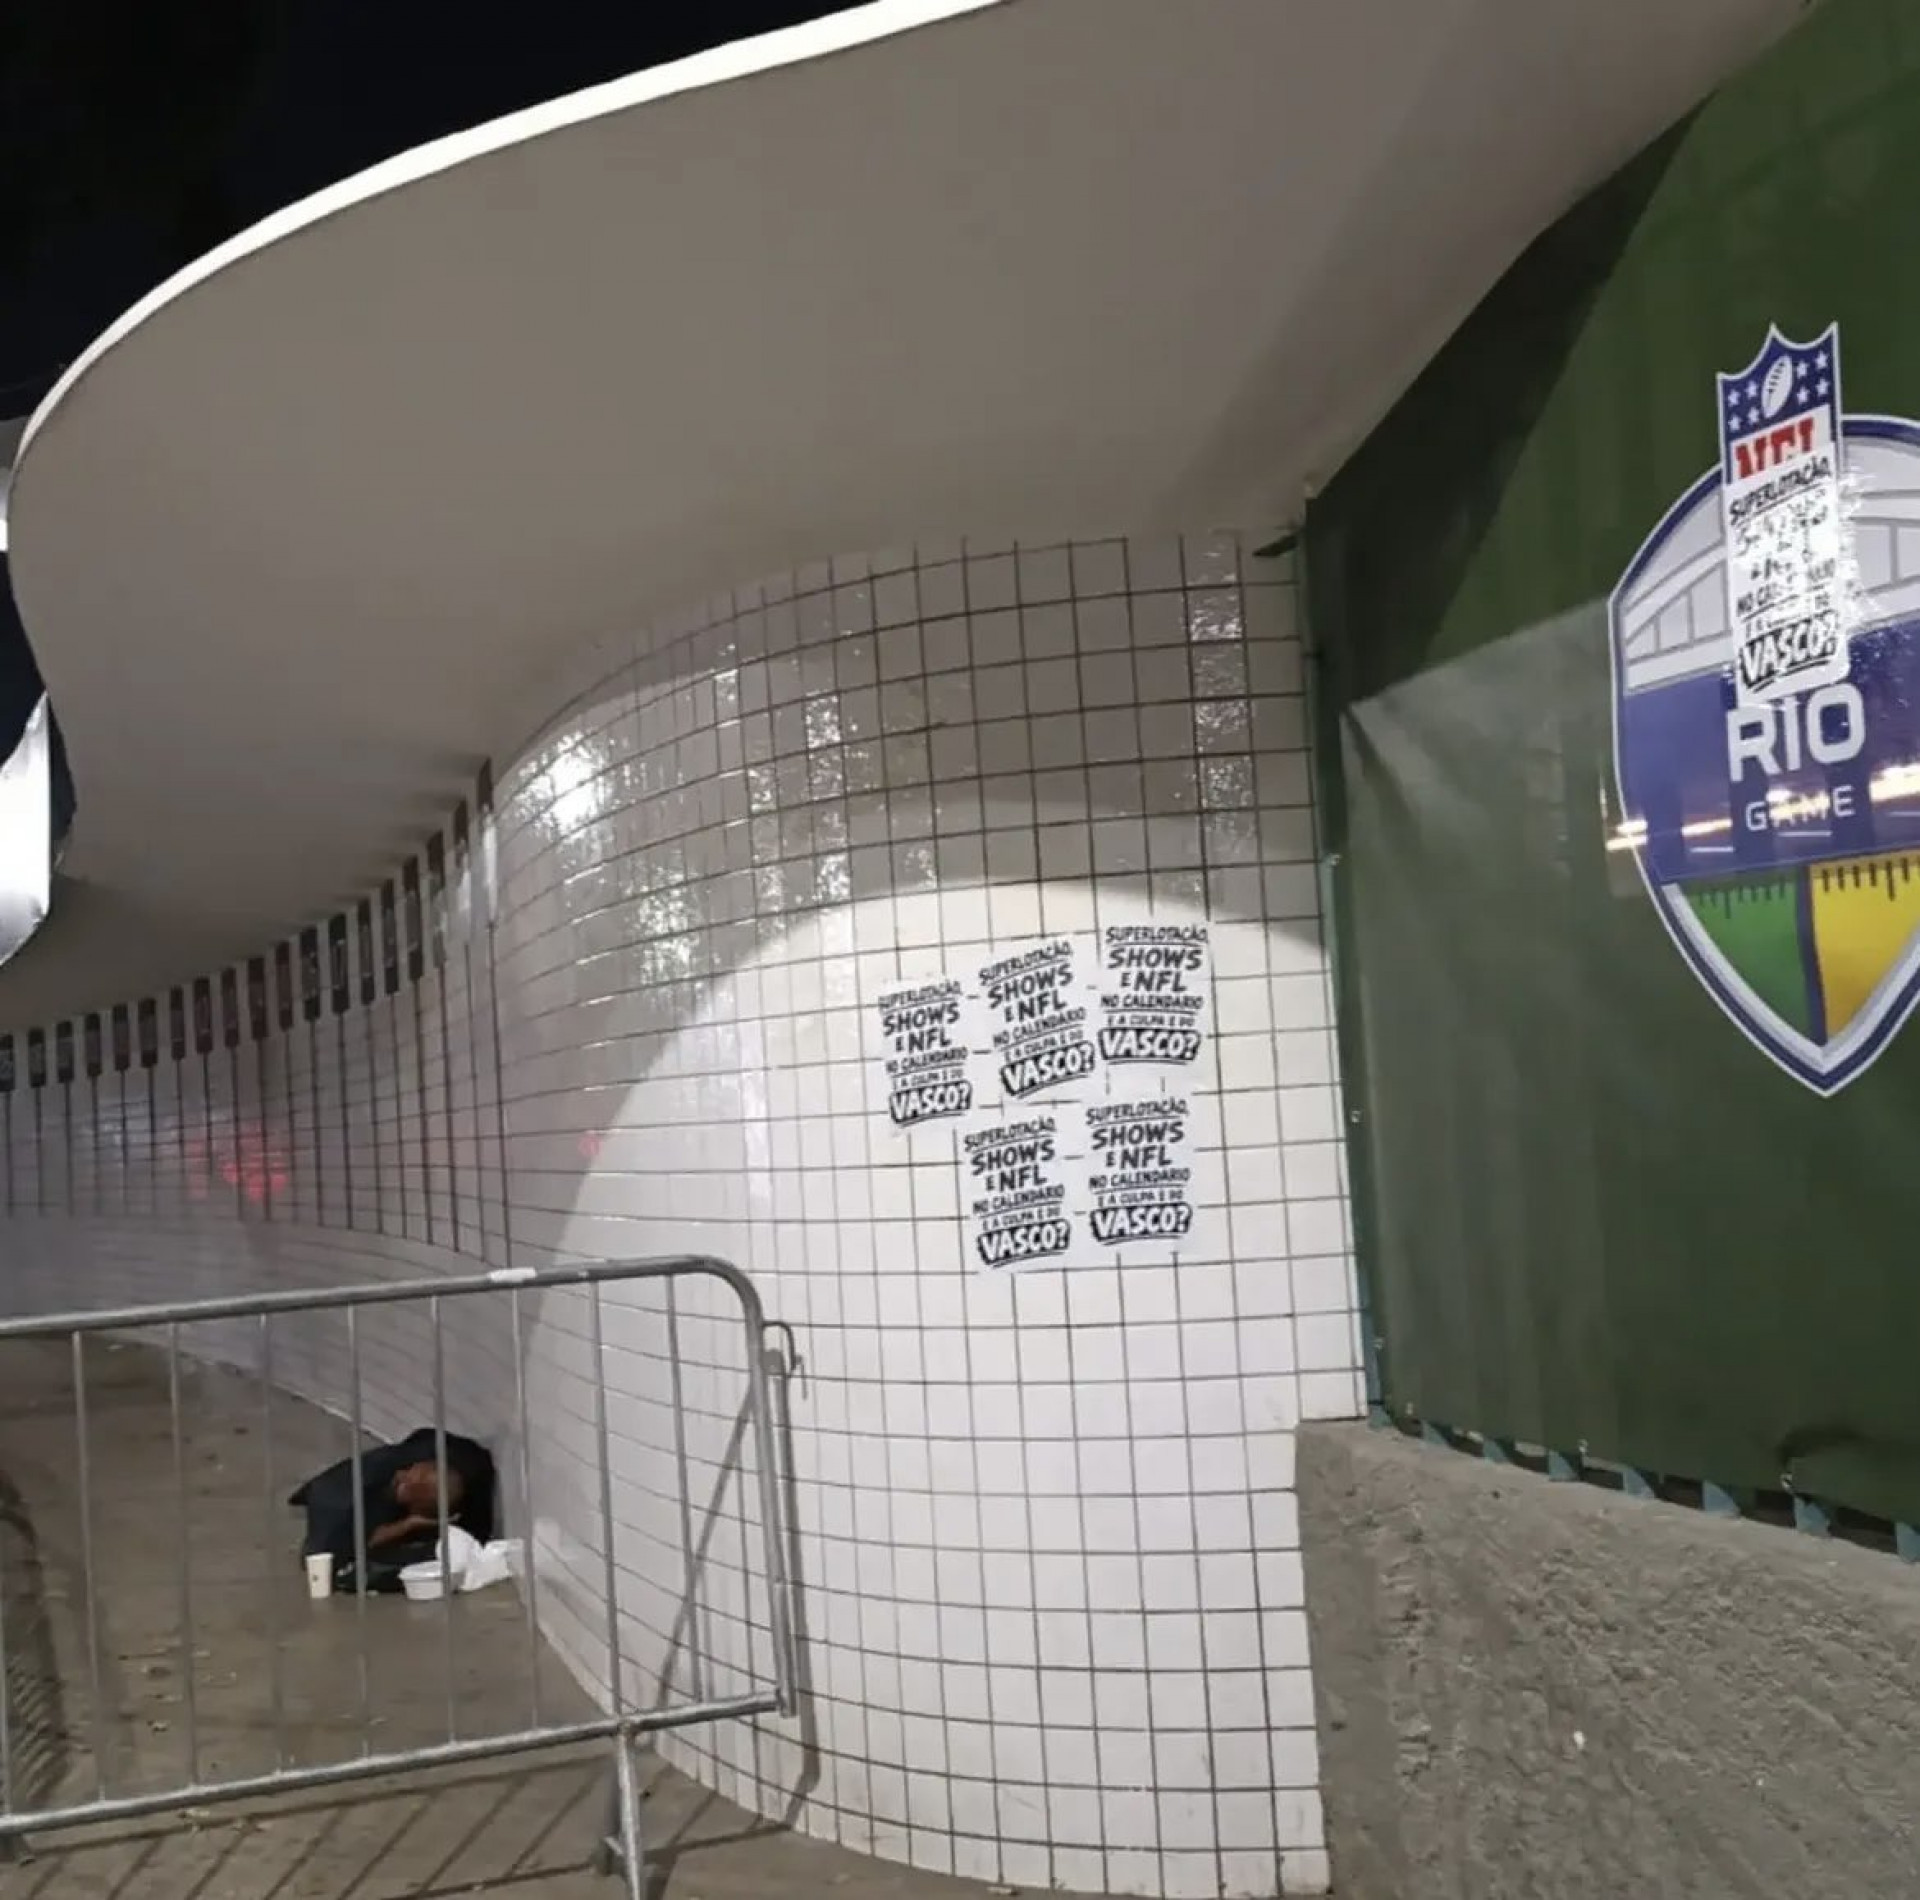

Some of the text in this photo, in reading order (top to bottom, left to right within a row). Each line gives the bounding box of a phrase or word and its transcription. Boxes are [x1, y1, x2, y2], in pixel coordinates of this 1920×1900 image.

[1727, 682, 1865, 782] RIO
[1745, 785, 1856, 831] GAME
[1107, 947, 1201, 970] SHOWS
[988, 963, 1073, 1009] SHOWS
[1120, 971, 1187, 991] E NFL
[884, 1002, 960, 1036] SHOWS
[1004, 989, 1067, 1022] E NFL
[896, 1027, 951, 1053] E NFL
[1101, 1029, 1198, 1059] VASCO?
[1003, 1043, 1092, 1092] VASCO?
[891, 1081, 970, 1121] VASCO?
[1091, 1122, 1184, 1150] SHOWS
[971, 1139, 1054, 1176] SHOWS
[1106, 1145, 1172, 1169] E NFL
[986, 1165, 1047, 1191] E NFL
[1093, 1205, 1190, 1238] VASCO?
[980, 1220, 1068, 1262] VASCO?
